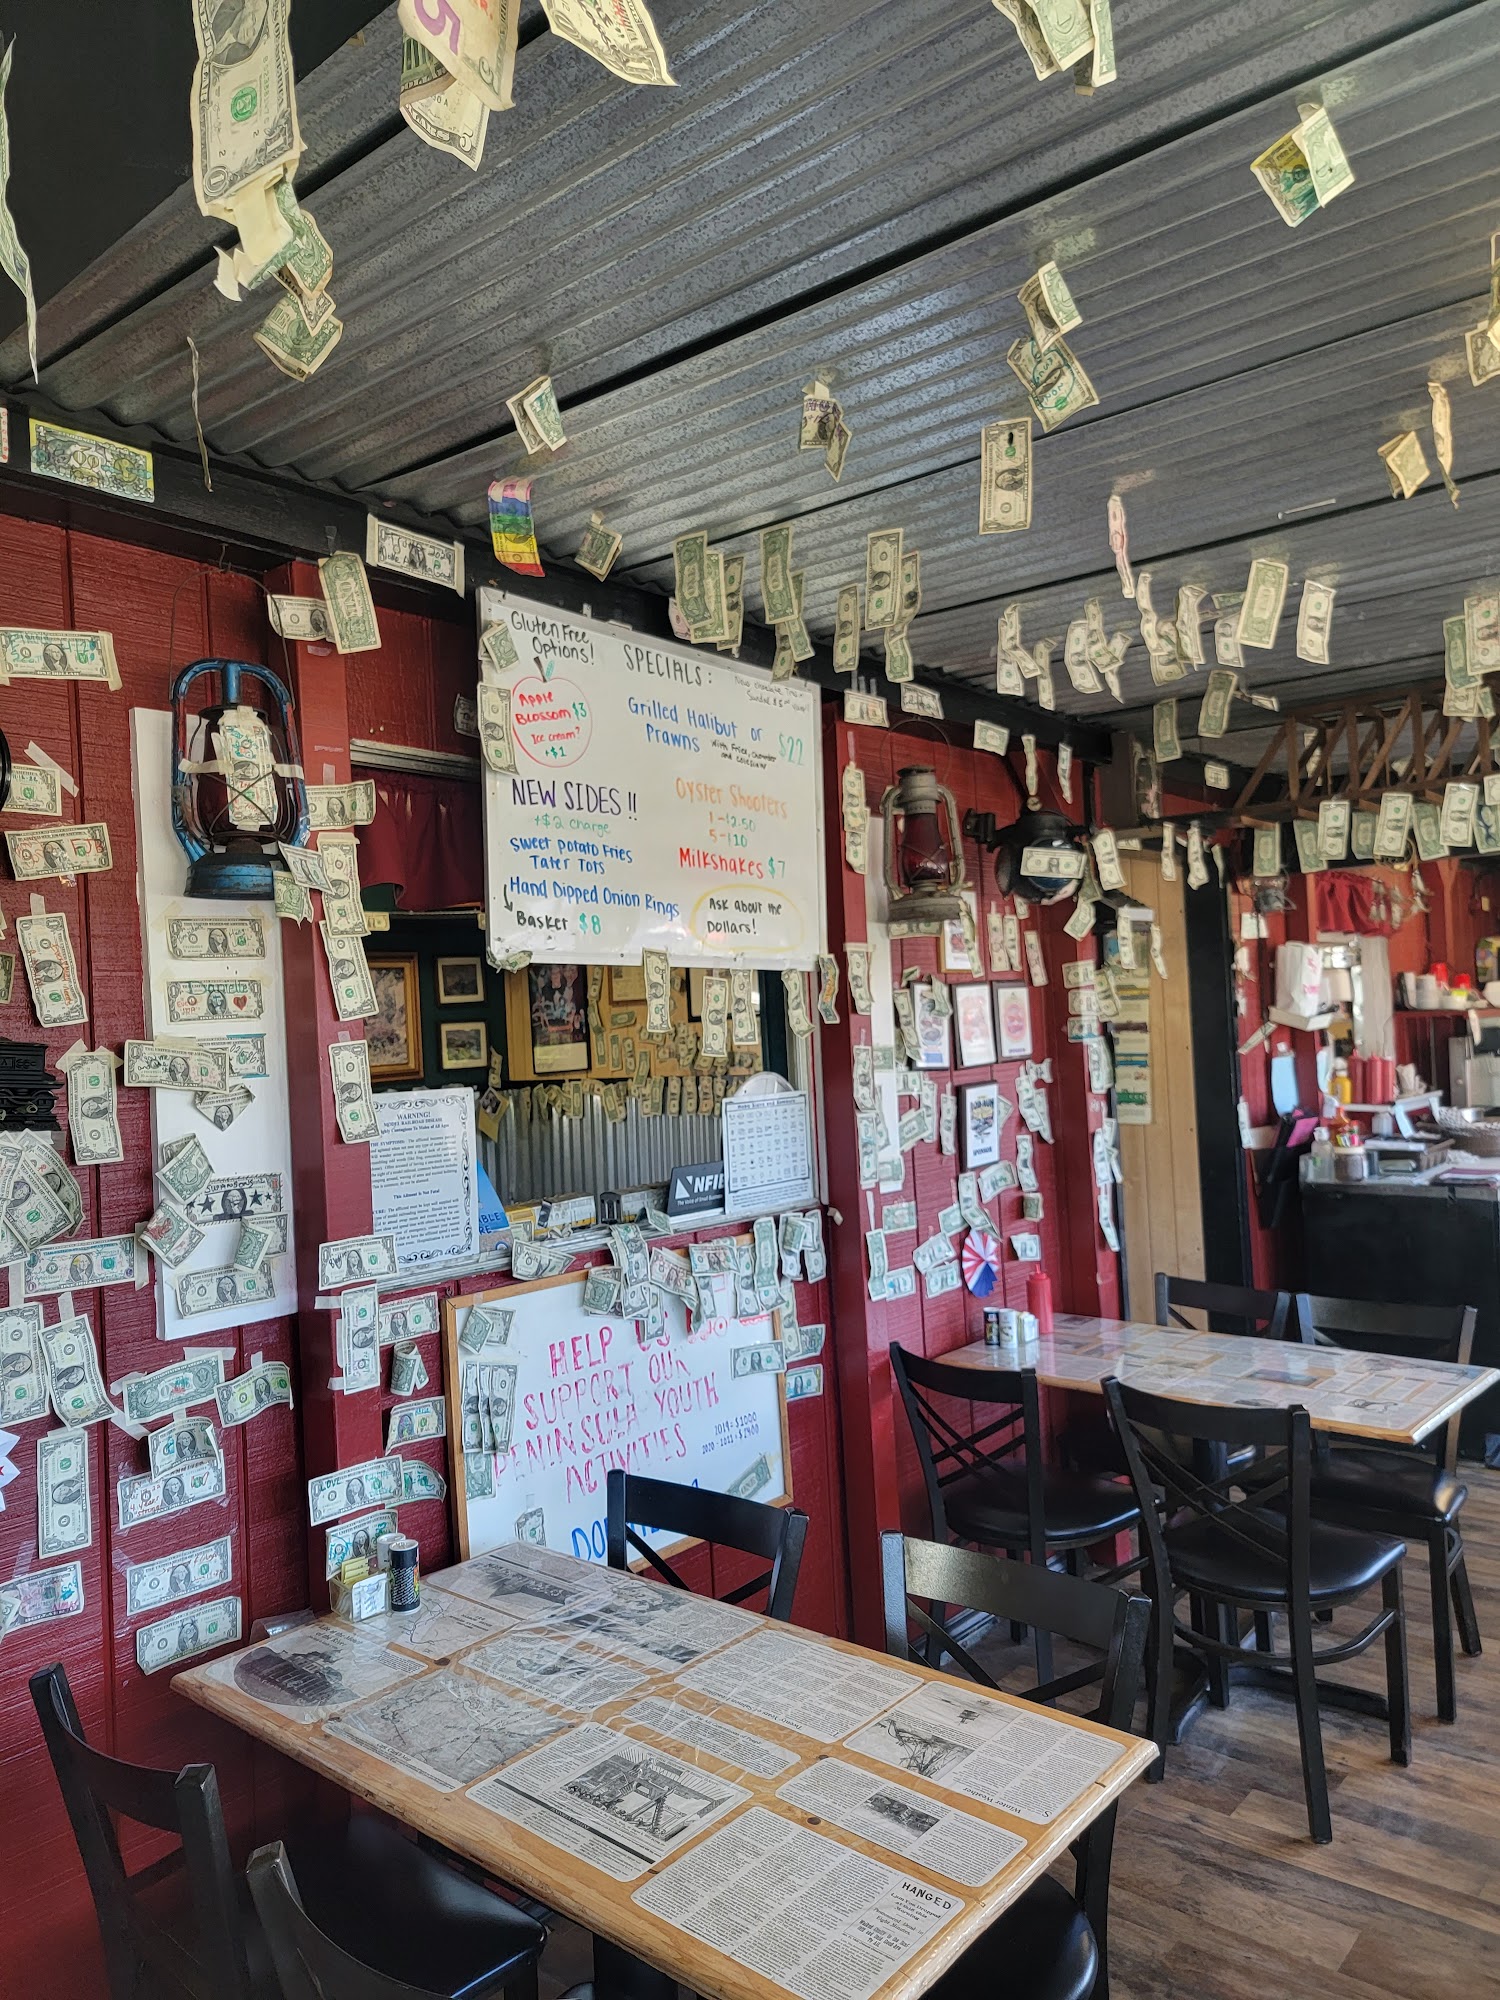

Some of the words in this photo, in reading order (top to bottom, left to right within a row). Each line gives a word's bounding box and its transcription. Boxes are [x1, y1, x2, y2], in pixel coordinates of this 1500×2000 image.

[511, 610, 559, 642] Gluten
[560, 625, 590, 644] Free
[532, 636, 595, 666] Options!
[572, 702, 587, 720] $3
[628, 697, 678, 724] Grilled
[686, 707, 738, 739] Halibut
[751, 727, 763, 742] or
[646, 724, 701, 754] Prawns
[779, 733, 805, 766] $22
[512, 778, 556, 808] NEW
[565, 781, 622, 816] SIDES
[569, 817, 611, 838] charge
[529, 855, 570, 871] Tater
[578, 858, 605, 875] Tots
[602, 843, 634, 864] Fries
[679, 847, 764, 879] Milkshakes
[768, 856, 786, 879] $7
[510, 876, 548, 899] Hand
[552, 881, 599, 904] Dipped
[603, 887, 640, 907] Onion
[645, 894, 680, 921] Rings
[734, 898, 764, 914] about
[766, 901, 783, 915] the
[516, 911, 569, 931] Basket
[579, 912, 602, 936] $8
[707, 918, 757, 935] Dollars!
[397, 1111, 431, 1120] WARNING!
[549, 1326, 613, 1378] HELP
[524, 1361, 634, 1431] SUPPORT
[649, 1351, 691, 1384] OUR
[494, 1403, 638, 1487] PENINSULA
[654, 1372, 719, 1420] YOUTH
[566, 1424, 687, 1503] ACTIVITIES
[962, 1787, 994, 1803] Weather
[995, 1799, 1022, 1814] Winter
[902, 1881, 952, 1911] HANGED
